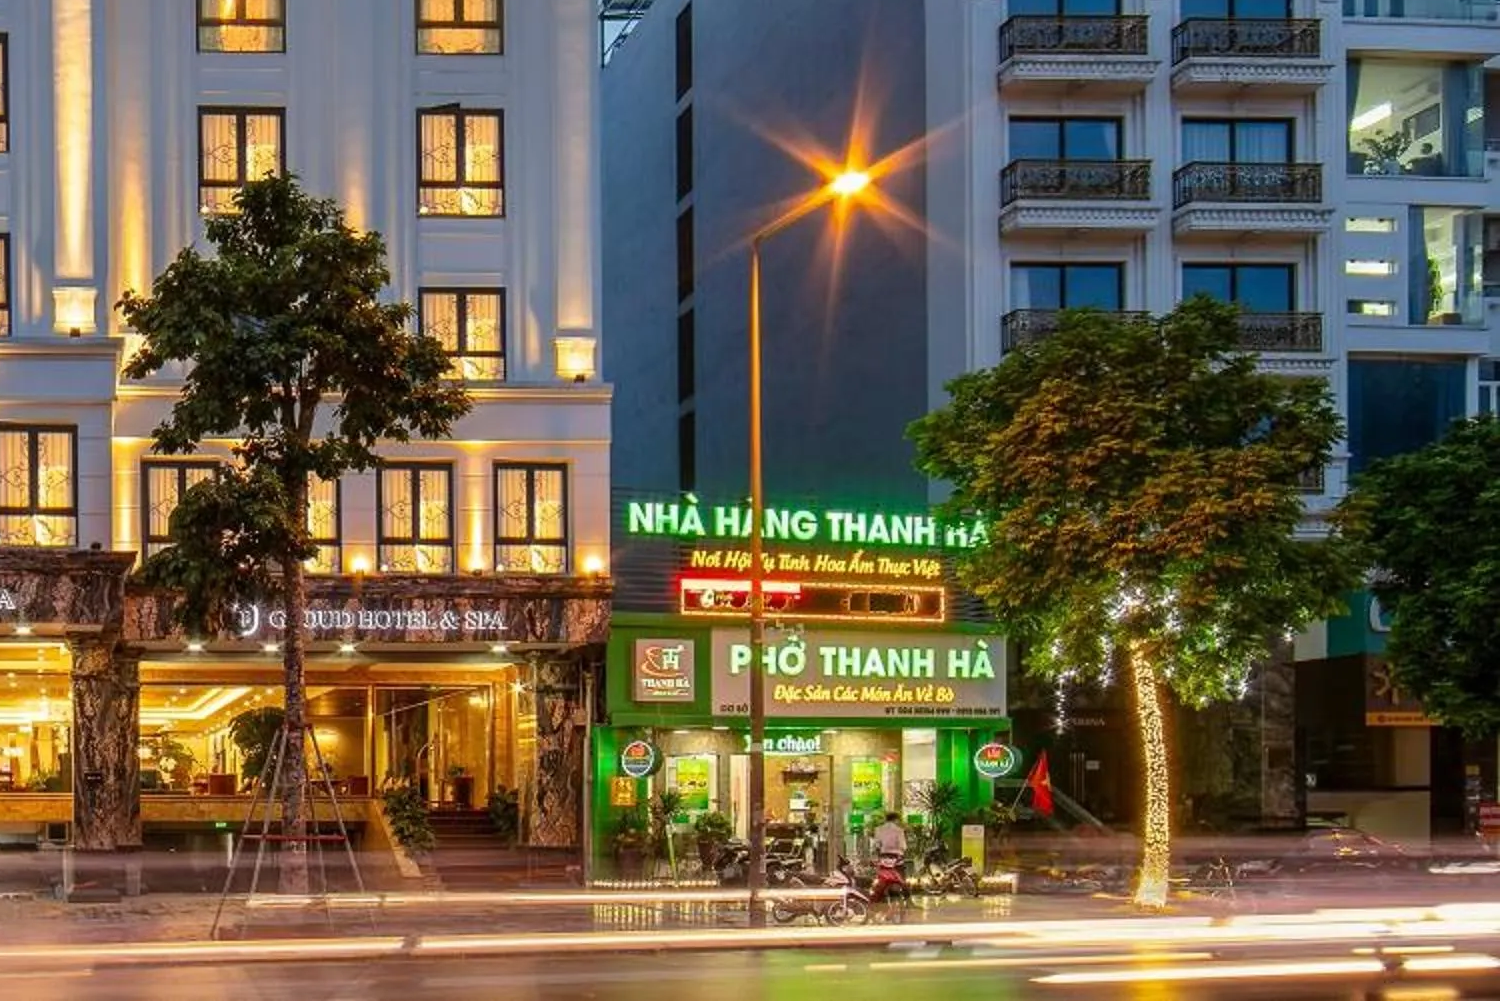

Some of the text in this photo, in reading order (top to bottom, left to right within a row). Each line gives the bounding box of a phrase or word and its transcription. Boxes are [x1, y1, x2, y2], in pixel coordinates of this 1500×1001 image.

[630, 492, 705, 535] NHÀ
[826, 512, 936, 546] THANH
[814, 554, 846, 573] Hoa
[357, 609, 437, 630] HOTEL
[438, 610, 460, 630] &
[464, 610, 509, 630] SPA
[819, 646, 936, 678] THANH
[947, 639, 996, 679] HÀ
[833, 685, 860, 702] Các
[860, 685, 891, 702] Món
[935, 686, 955, 703] Bò
